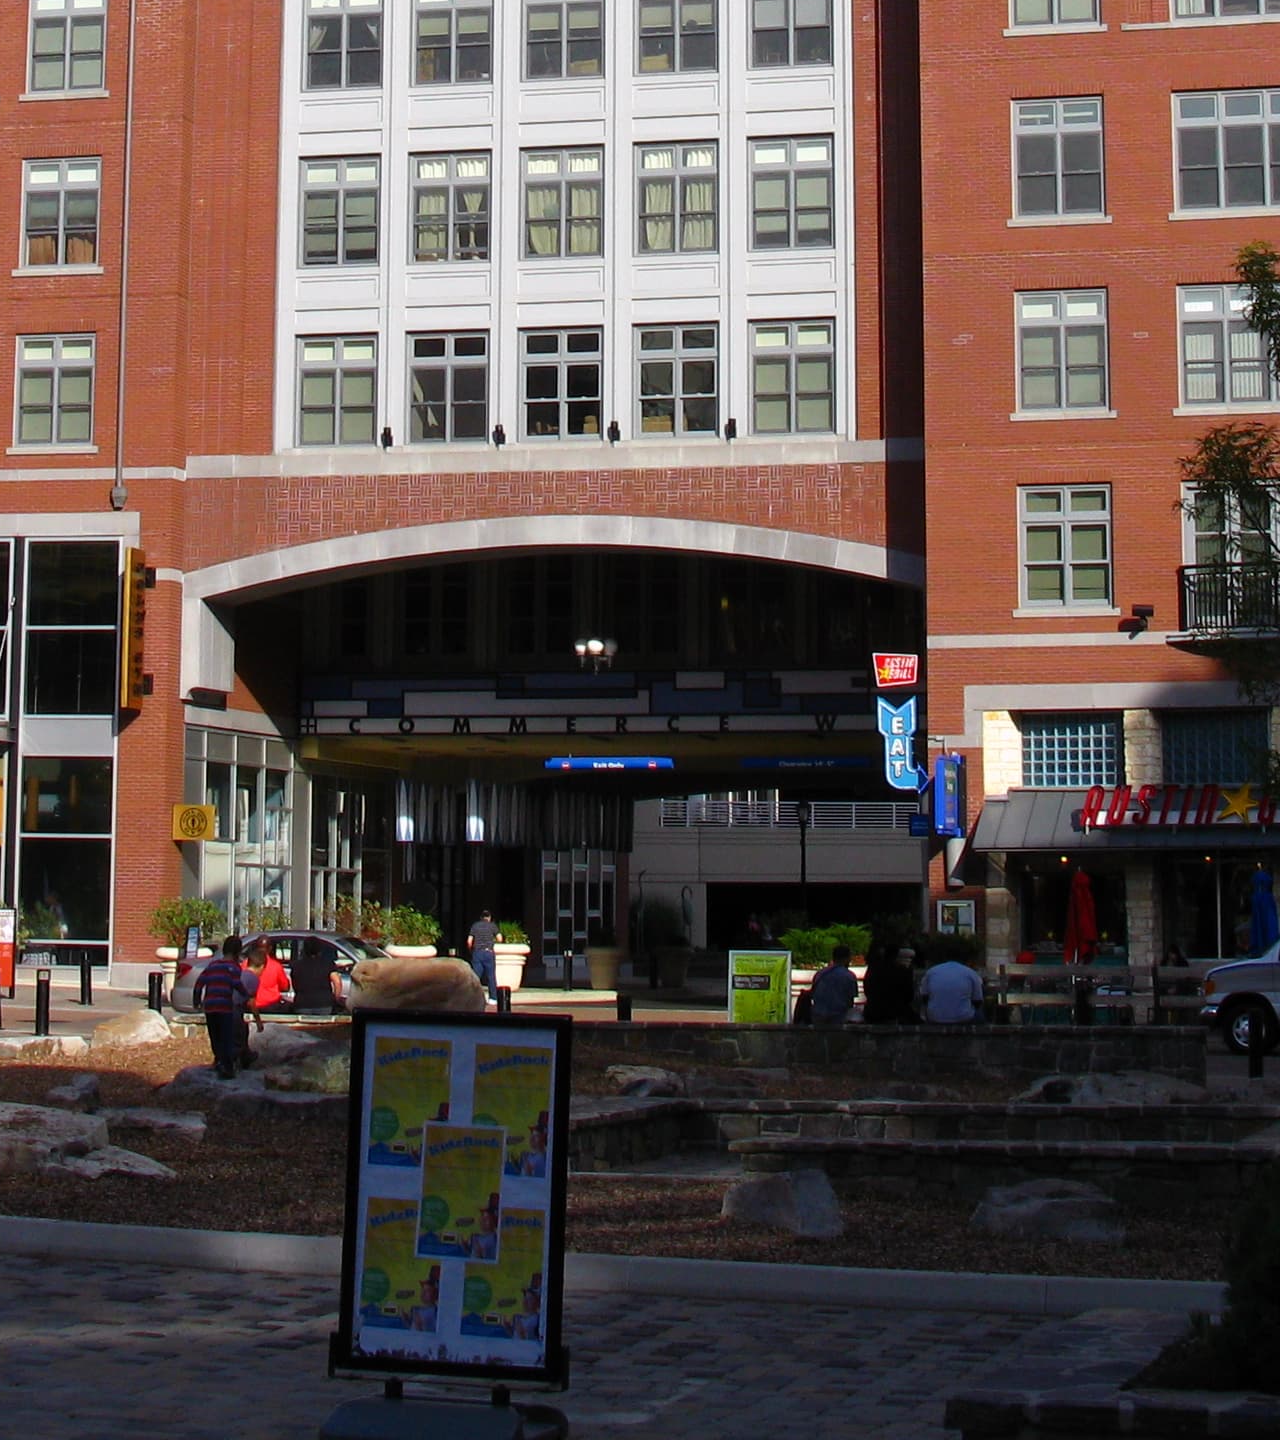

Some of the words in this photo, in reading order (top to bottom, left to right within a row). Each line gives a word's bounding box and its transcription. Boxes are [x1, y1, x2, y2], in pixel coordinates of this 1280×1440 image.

[348, 715, 729, 734] COMMERCE
[890, 716, 905, 778] EAT
[1080, 784, 1221, 826] AUSTIN
